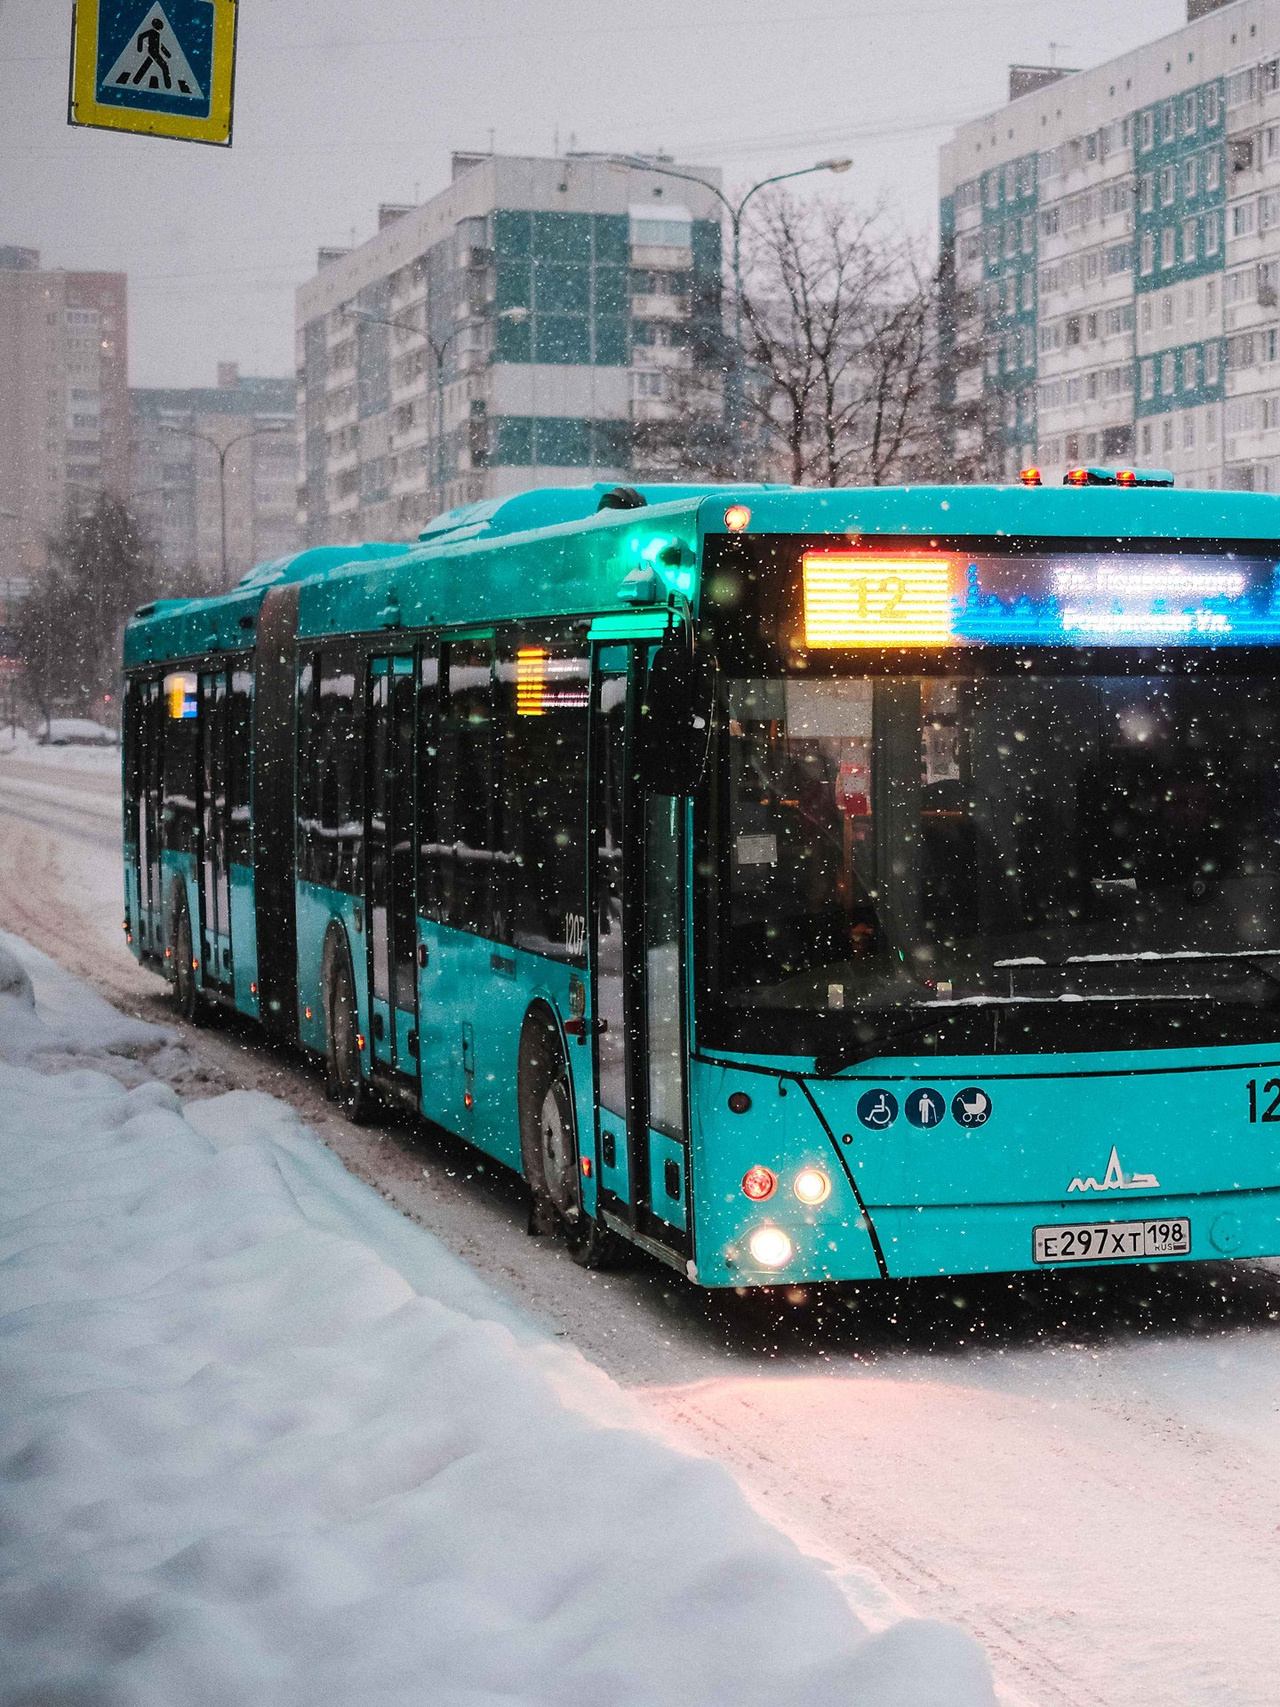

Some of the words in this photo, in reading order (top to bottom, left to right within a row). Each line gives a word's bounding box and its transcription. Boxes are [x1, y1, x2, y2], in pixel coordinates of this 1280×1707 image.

[849, 576, 908, 618] 12
[565, 912, 585, 956] 1207
[1044, 1228, 1141, 1258] Е297ХТ
[1147, 1223, 1183, 1244] 198
[1154, 1243, 1173, 1252] RUS
